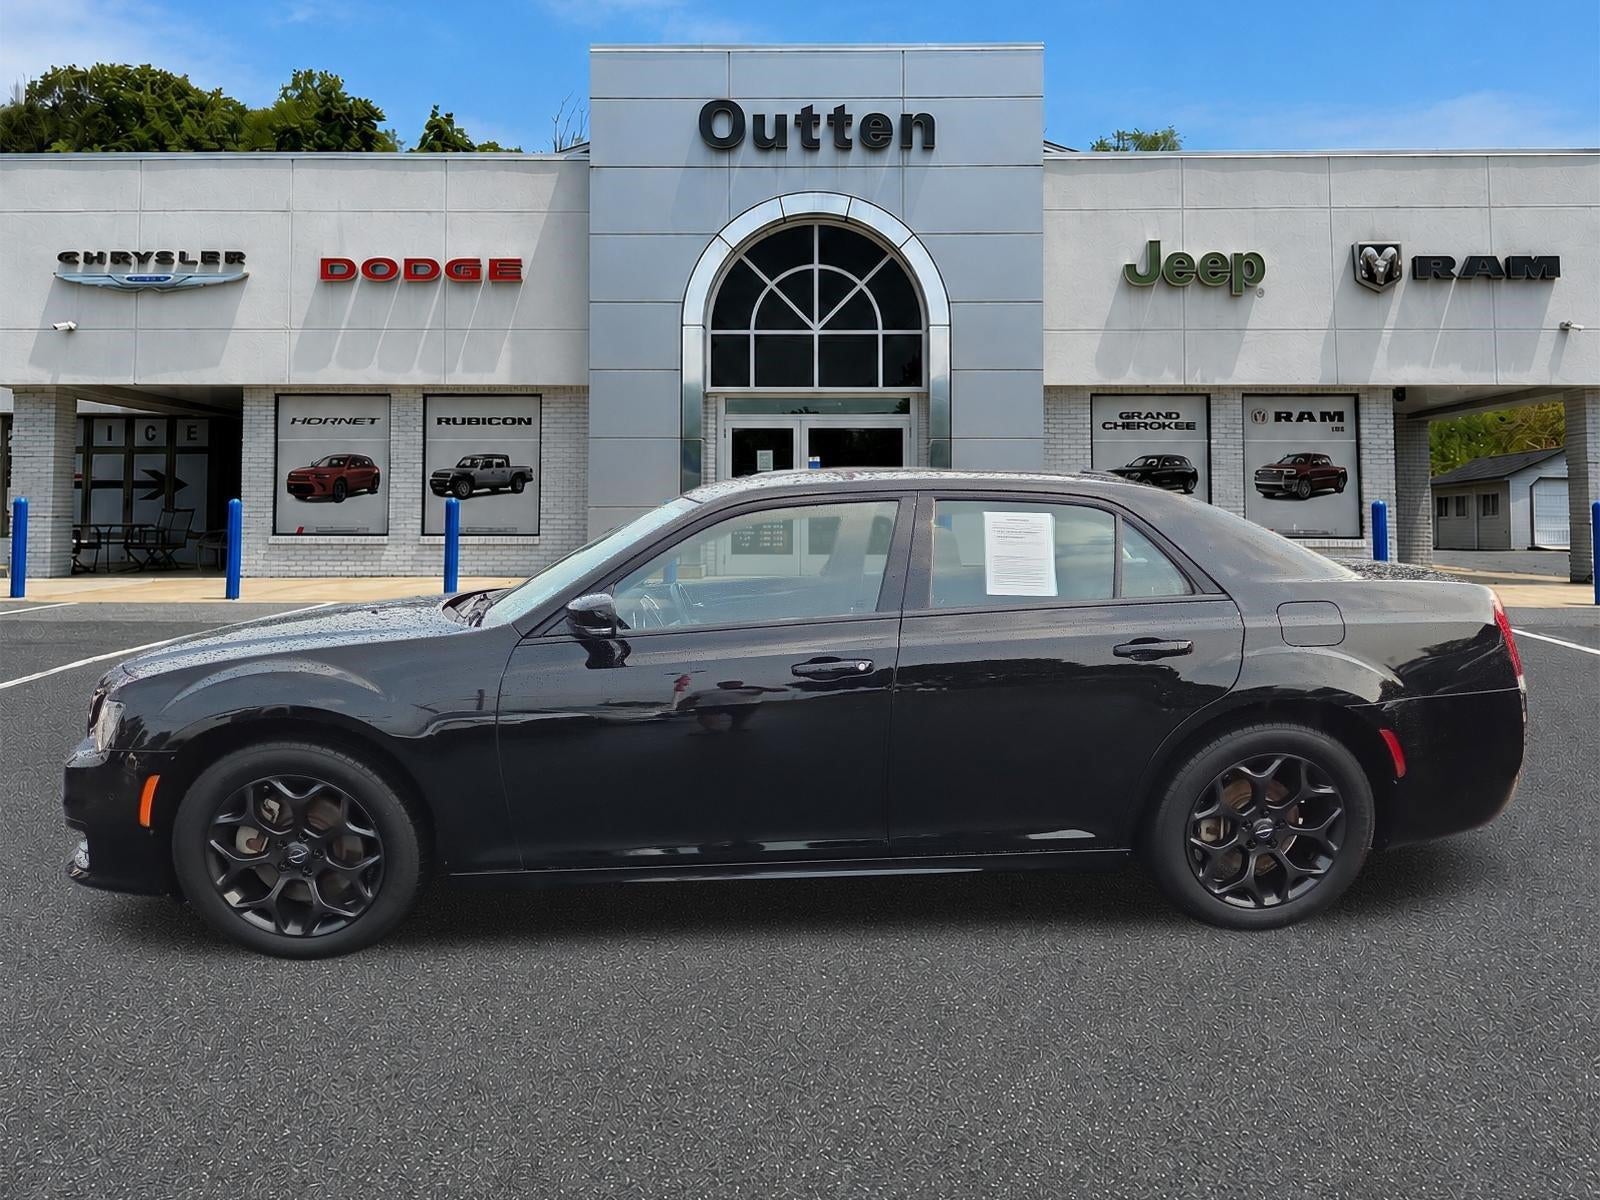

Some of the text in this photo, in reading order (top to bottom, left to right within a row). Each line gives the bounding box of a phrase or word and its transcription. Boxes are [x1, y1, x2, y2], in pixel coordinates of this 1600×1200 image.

[699, 99, 936, 150] Outten
[57, 250, 247, 266] CHRYSLER
[320, 257, 523, 283] DODGE
[1123, 239, 1267, 297] Jeep
[1411, 255, 1561, 281] RAM
[290, 416, 381, 426] HORNET
[436, 416, 533, 427] RUBICON
[1118, 411, 1181, 421] GRAND
[1274, 411, 1345, 423] RAM
[1101, 421, 1197, 431] CHEROKEE
